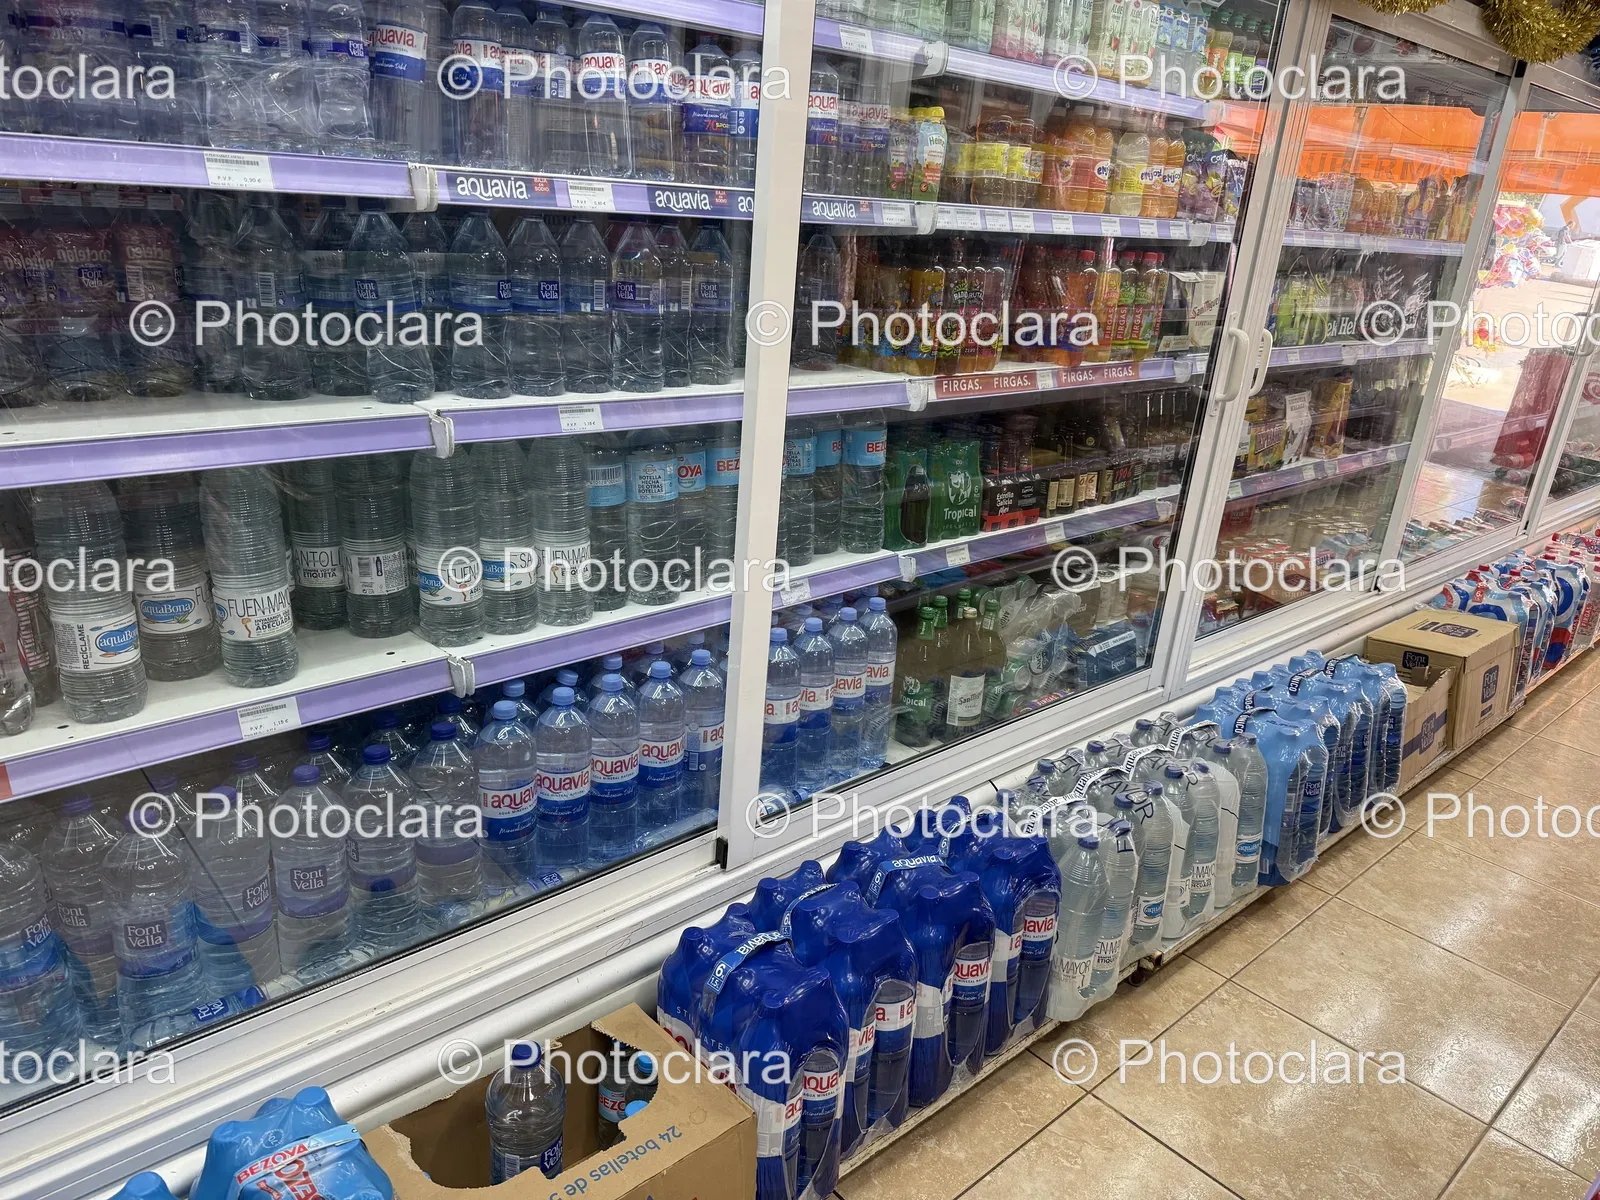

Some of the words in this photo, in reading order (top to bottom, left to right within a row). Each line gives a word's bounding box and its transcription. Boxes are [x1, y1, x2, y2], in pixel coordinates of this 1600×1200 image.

[1140, 169, 1163, 182] enjoy
[1162, 171, 1182, 184] enjoy
[456, 176, 529, 201] aquavia
[654, 190, 712, 213] aquavia
[812, 200, 857, 220] aquavia
[355, 280, 375, 291] Font
[540, 281, 558, 291] Font
[616, 281, 634, 291] Font
[700, 282, 718, 292] Font
[356, 289, 377, 300] Vella
[540, 290, 559, 299] Vella
[617, 290, 635, 300] Vella
[700, 290, 718, 300] Vella
[943, 505, 977, 521] Tropical
[303, 570, 337, 579] ETIQUETA
[142, 602, 192, 618] aquaBona
[255, 616, 291, 632] ADECUADA
[1405, 652, 1426, 664] Font
[1484, 669, 1498, 685] Font
[1483, 683, 1497, 699] Vella
[590, 752, 639, 777] aquavia
[536, 771, 590, 795] aquavia
[1306, 782, 1321, 790] Font
[891, 854, 936, 869] aquavia
[293, 868, 324, 882] Font
[247, 878, 269, 901] Font
[294, 878, 326, 891] Vella
[57, 903, 85, 918] Font
[24, 913, 50, 938] Font
[59, 913, 88, 928] Vella
[126, 925, 161, 936] Font
[128, 935, 164, 948] Vella
[658, 1125, 683, 1144] 24
[236, 1143, 309, 1185] BEZOYA
[588, 1138, 661, 1182] botellas
[563, 1178, 588, 1197] de
